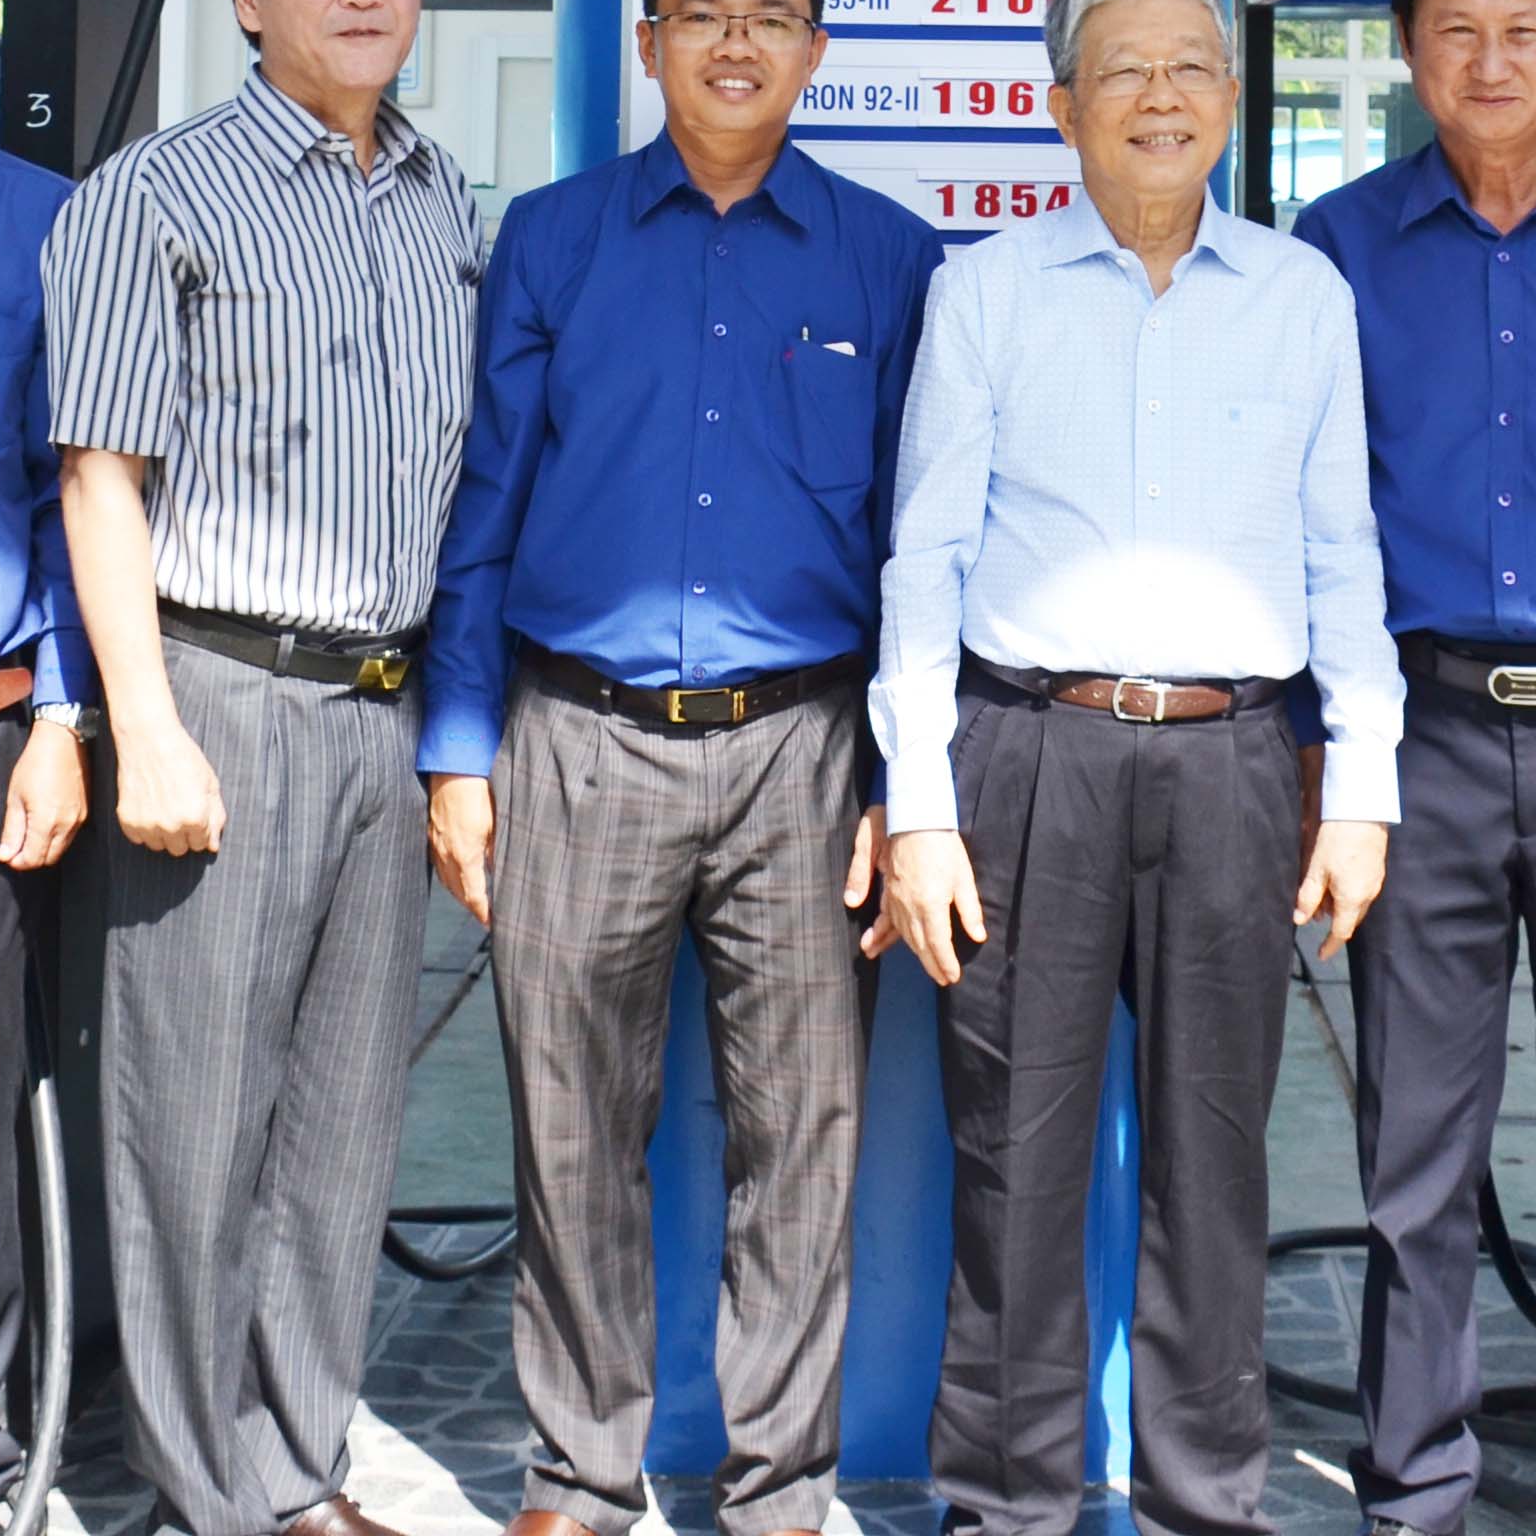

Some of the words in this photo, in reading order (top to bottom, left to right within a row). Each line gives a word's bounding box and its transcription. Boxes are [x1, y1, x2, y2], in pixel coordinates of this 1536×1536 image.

[26, 93, 52, 128] 3
[802, 84, 855, 111] RON
[863, 85, 919, 112] 92-II
[931, 80, 1057, 116] 196
